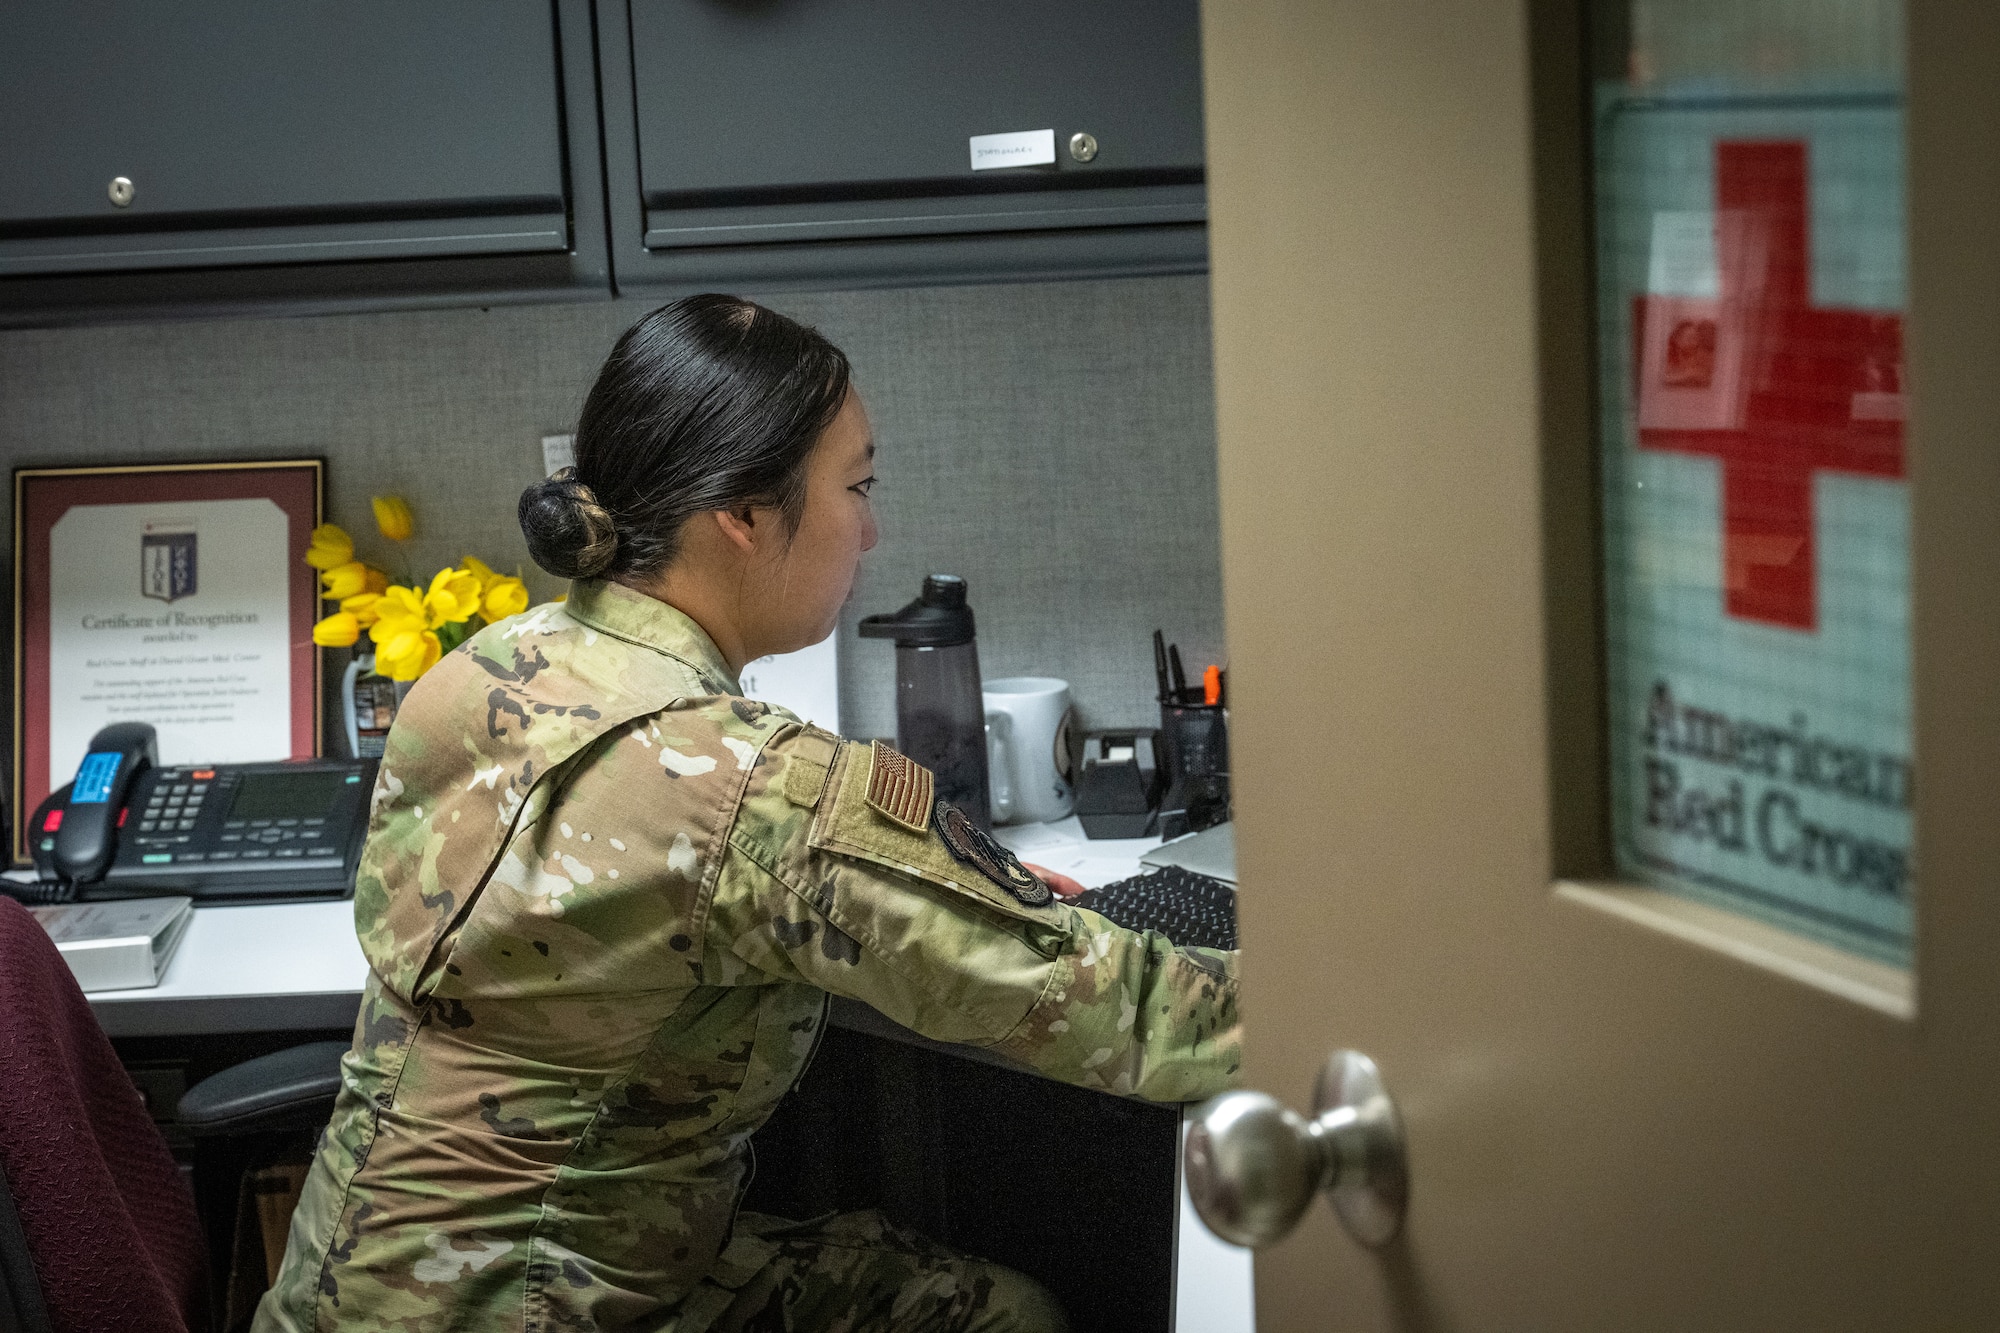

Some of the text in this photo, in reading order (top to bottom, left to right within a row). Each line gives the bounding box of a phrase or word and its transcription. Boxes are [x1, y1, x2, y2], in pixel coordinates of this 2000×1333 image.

[81, 611, 259, 631] Certificate of Recognition
[1646, 680, 1912, 812] American
[1647, 755, 1912, 900] Red Cross
